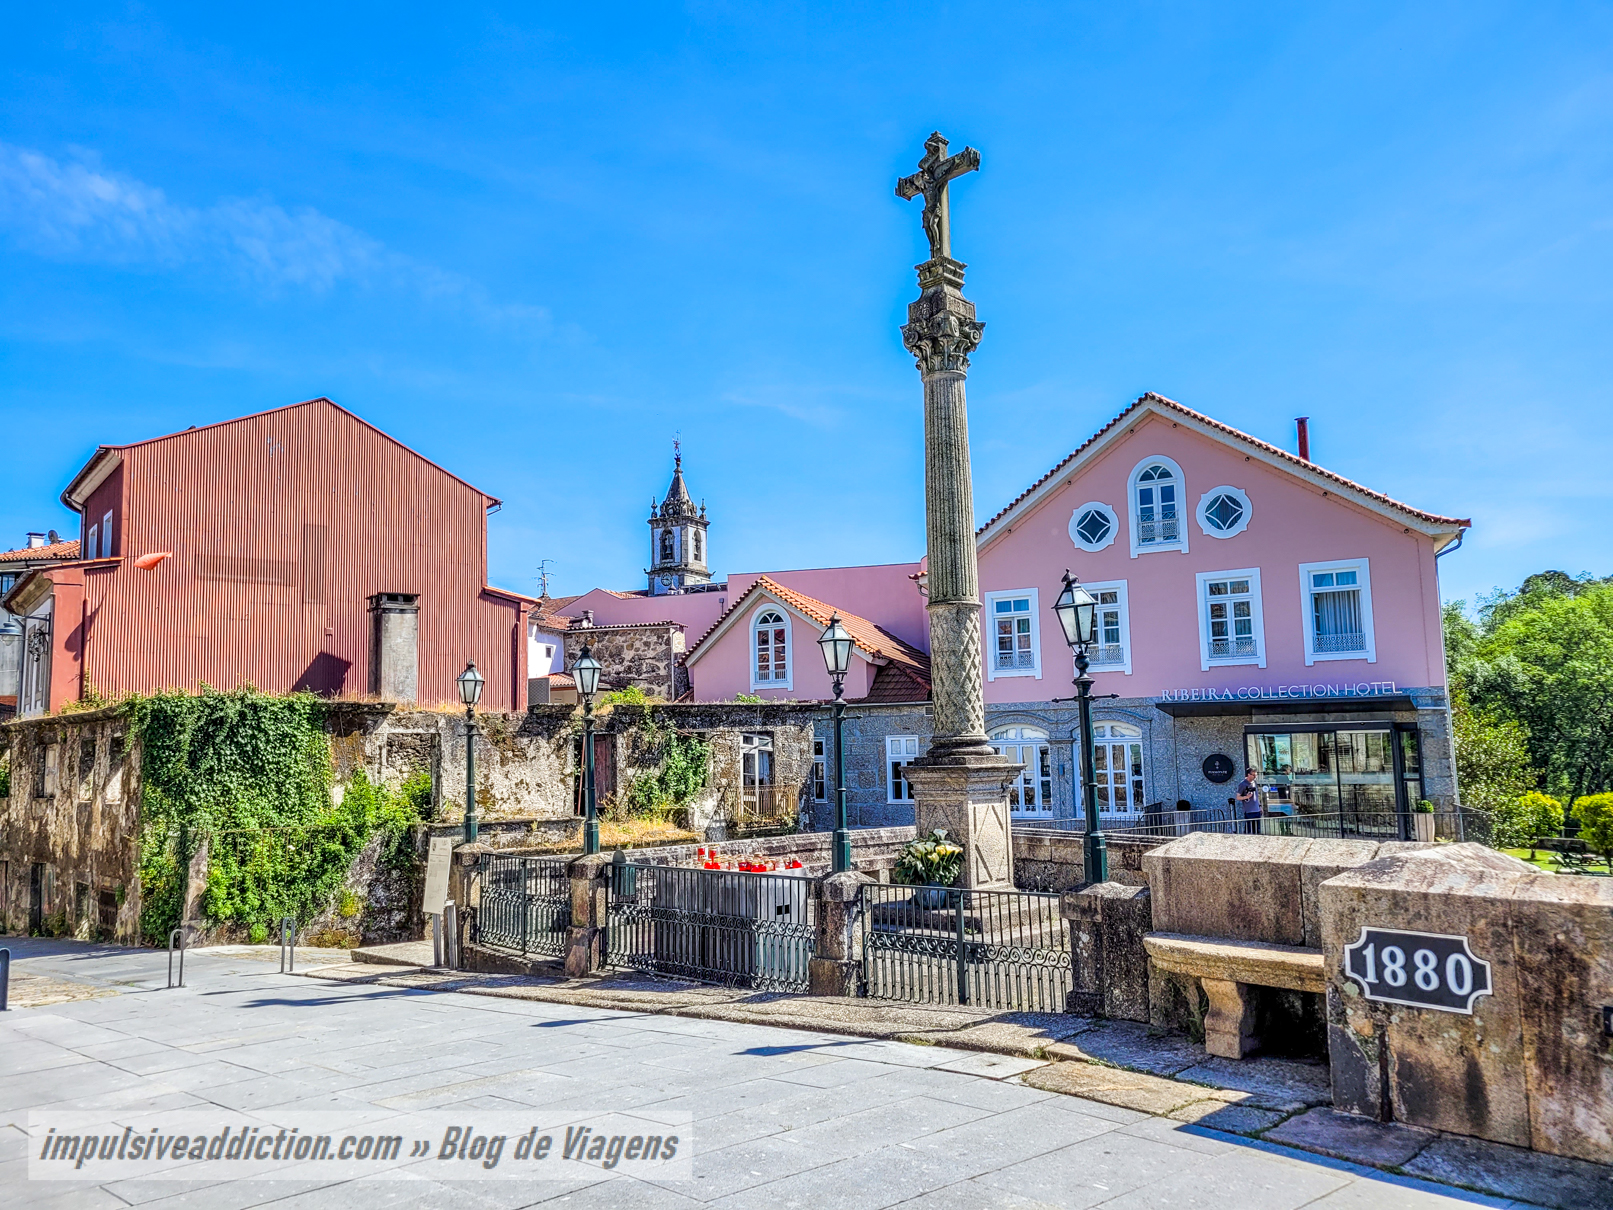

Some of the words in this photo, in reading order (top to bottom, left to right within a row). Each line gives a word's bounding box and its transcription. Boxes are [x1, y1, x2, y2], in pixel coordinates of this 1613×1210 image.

[1161, 687, 1234, 702] RIBEIRA
[1237, 683, 1339, 699] COLLECTION
[1344, 681, 1402, 697] HOTEL
[1362, 942, 1473, 996] 1880
